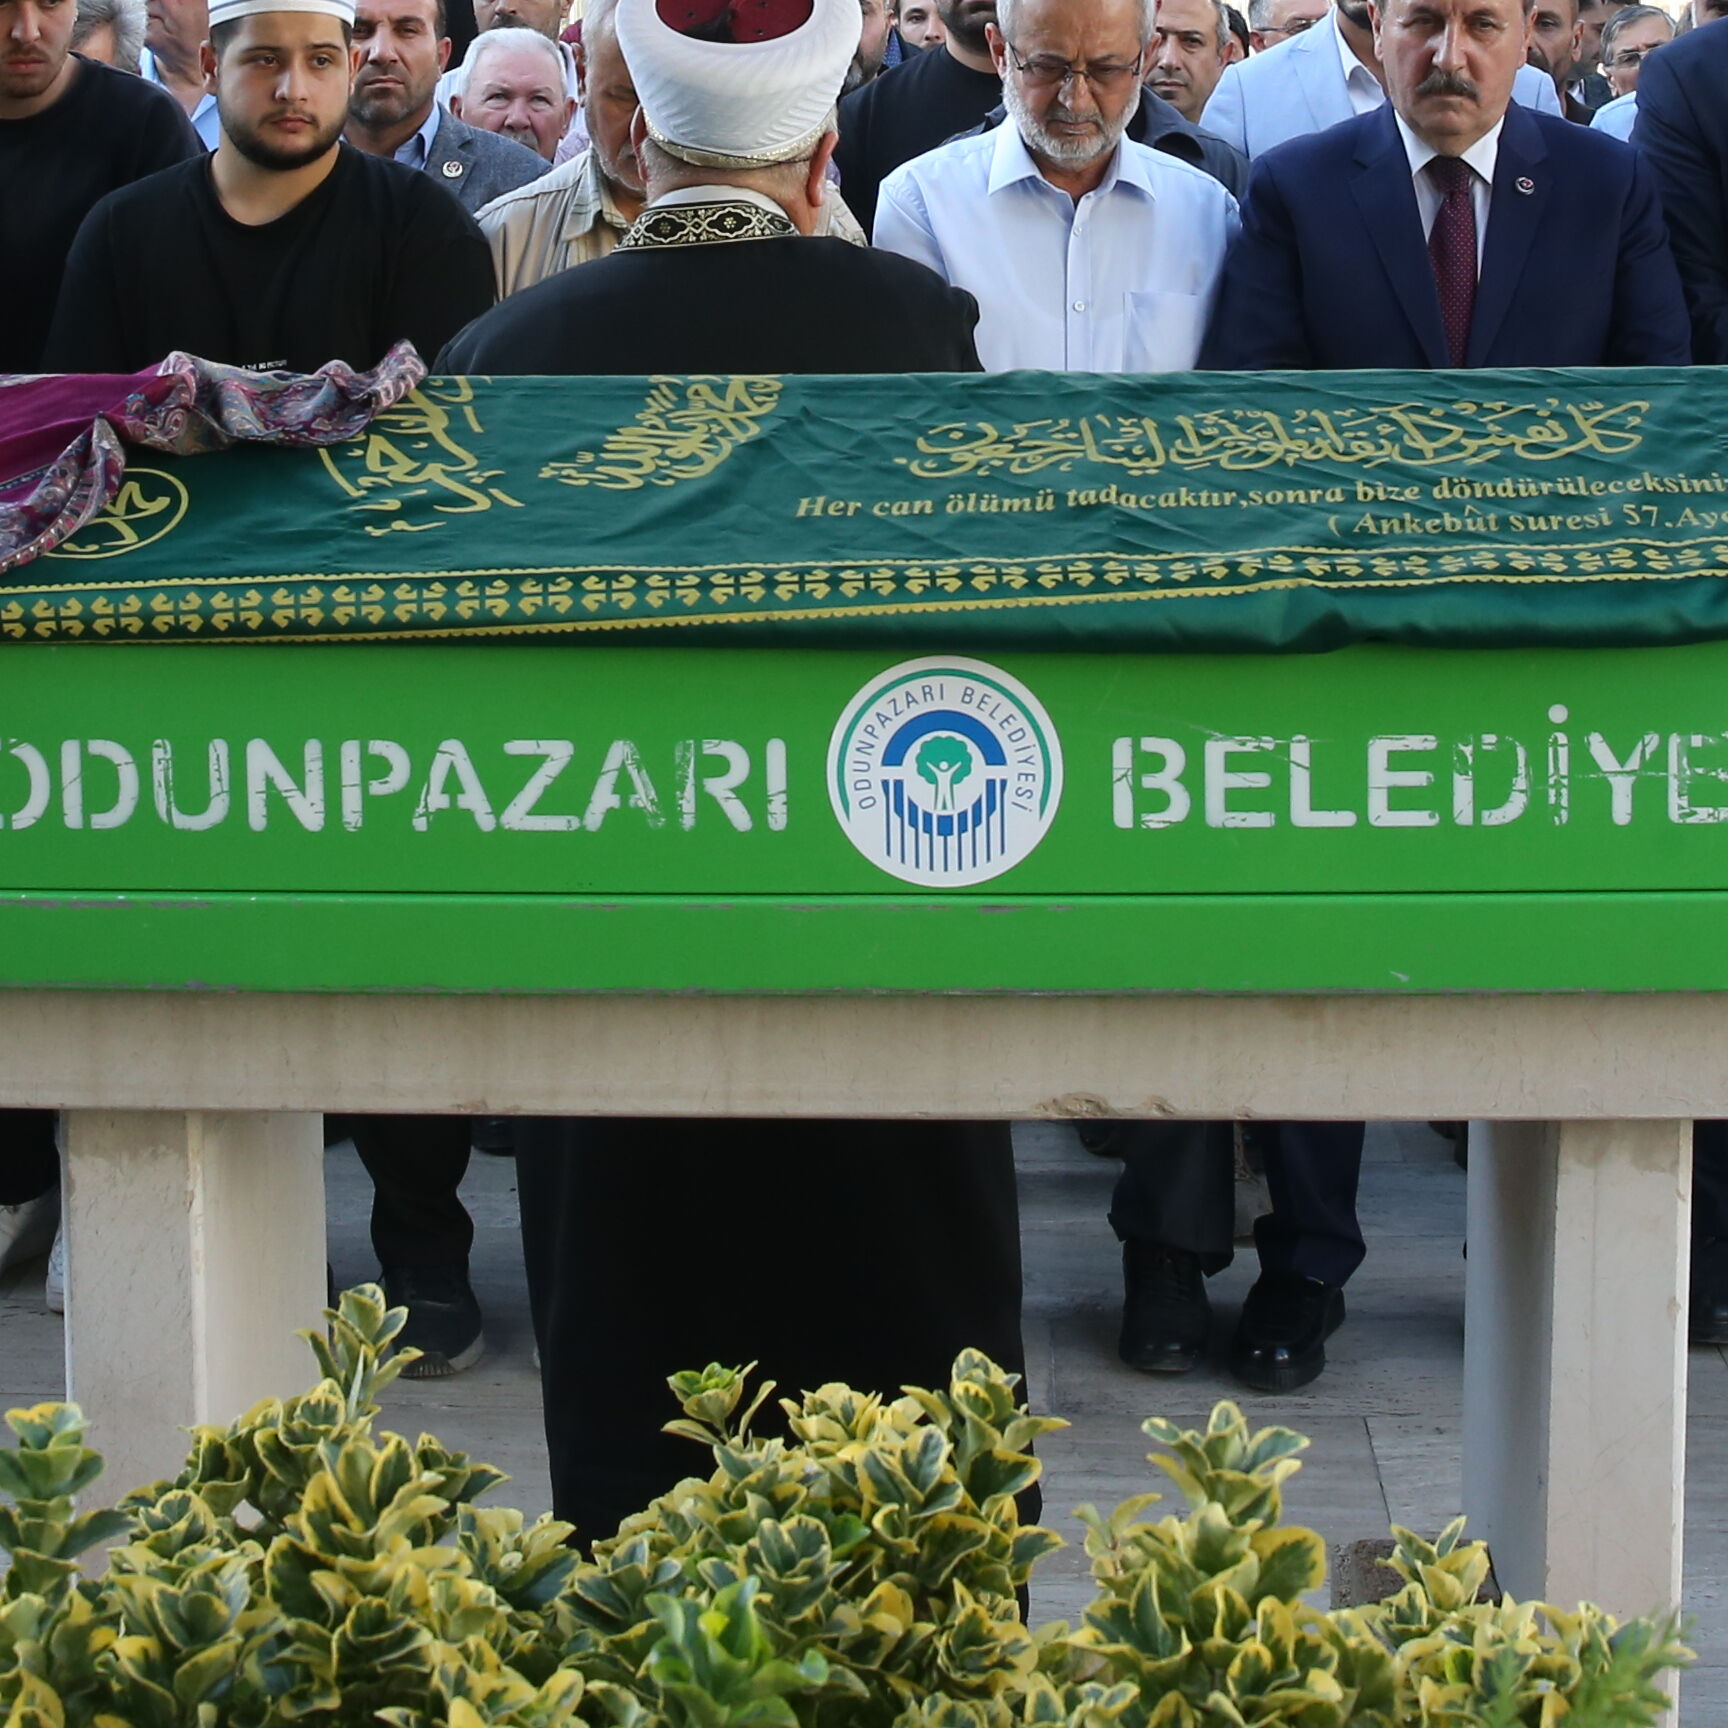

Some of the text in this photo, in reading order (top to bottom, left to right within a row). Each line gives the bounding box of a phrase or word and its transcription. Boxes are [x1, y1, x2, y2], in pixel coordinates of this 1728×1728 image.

[795, 495, 862, 517] Her
[873, 497, 933, 516] can
[946, 488, 1055, 514] ölümü
[1356, 478, 1421, 502] bize
[1353, 504, 1499, 535] Ankebût
[1509, 505, 1613, 532] suresi
[852, 683, 1037, 813] ODUNPAZARI BELEDİYESİ
